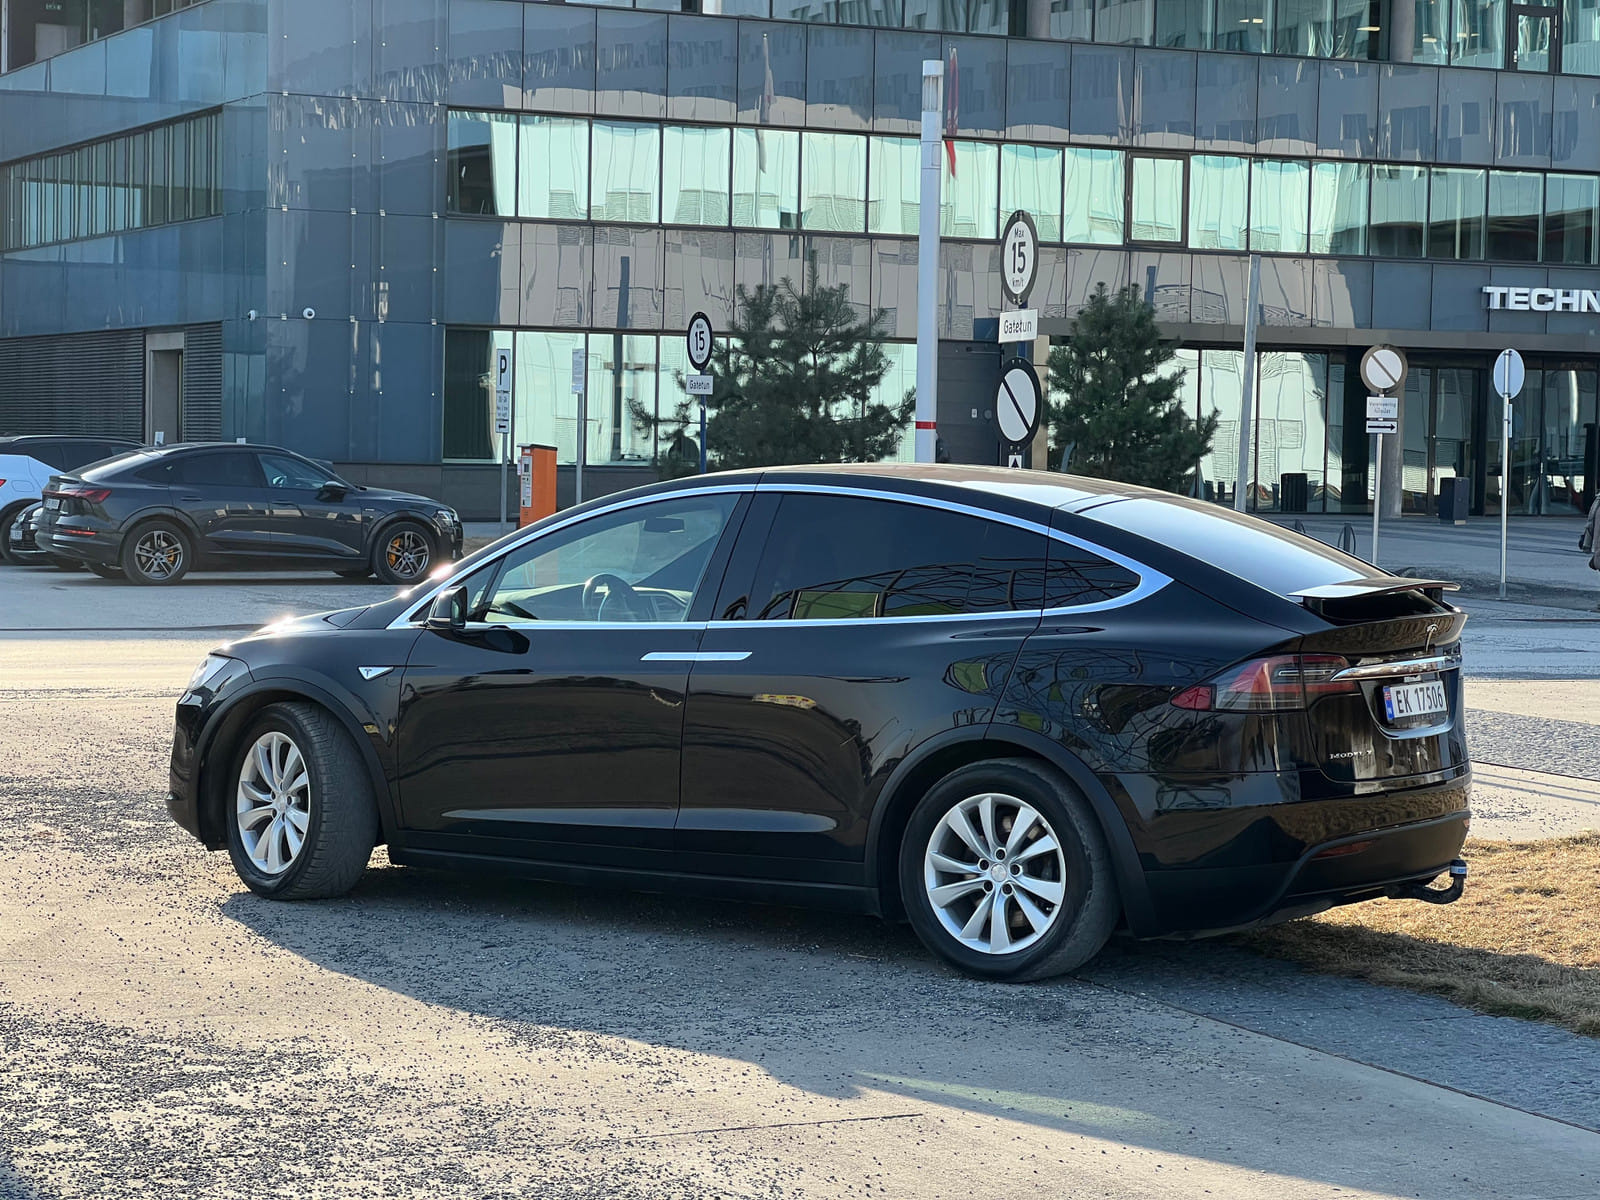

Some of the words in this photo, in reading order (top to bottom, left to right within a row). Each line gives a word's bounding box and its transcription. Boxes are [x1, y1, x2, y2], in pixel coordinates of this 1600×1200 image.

[1014, 227, 1024, 237] Max
[1012, 241, 1026, 273] 15
[1012, 278, 1024, 287] km/t
[1482, 286, 1600, 312] TECHN
[1003, 320, 1032, 334] Gatetun
[694, 330, 705, 352] 15
[500, 355, 507, 386] P
[690, 379, 710, 390] Gatetun
[1395, 689, 1412, 714] EK
[1414, 685, 1444, 711] 17506
